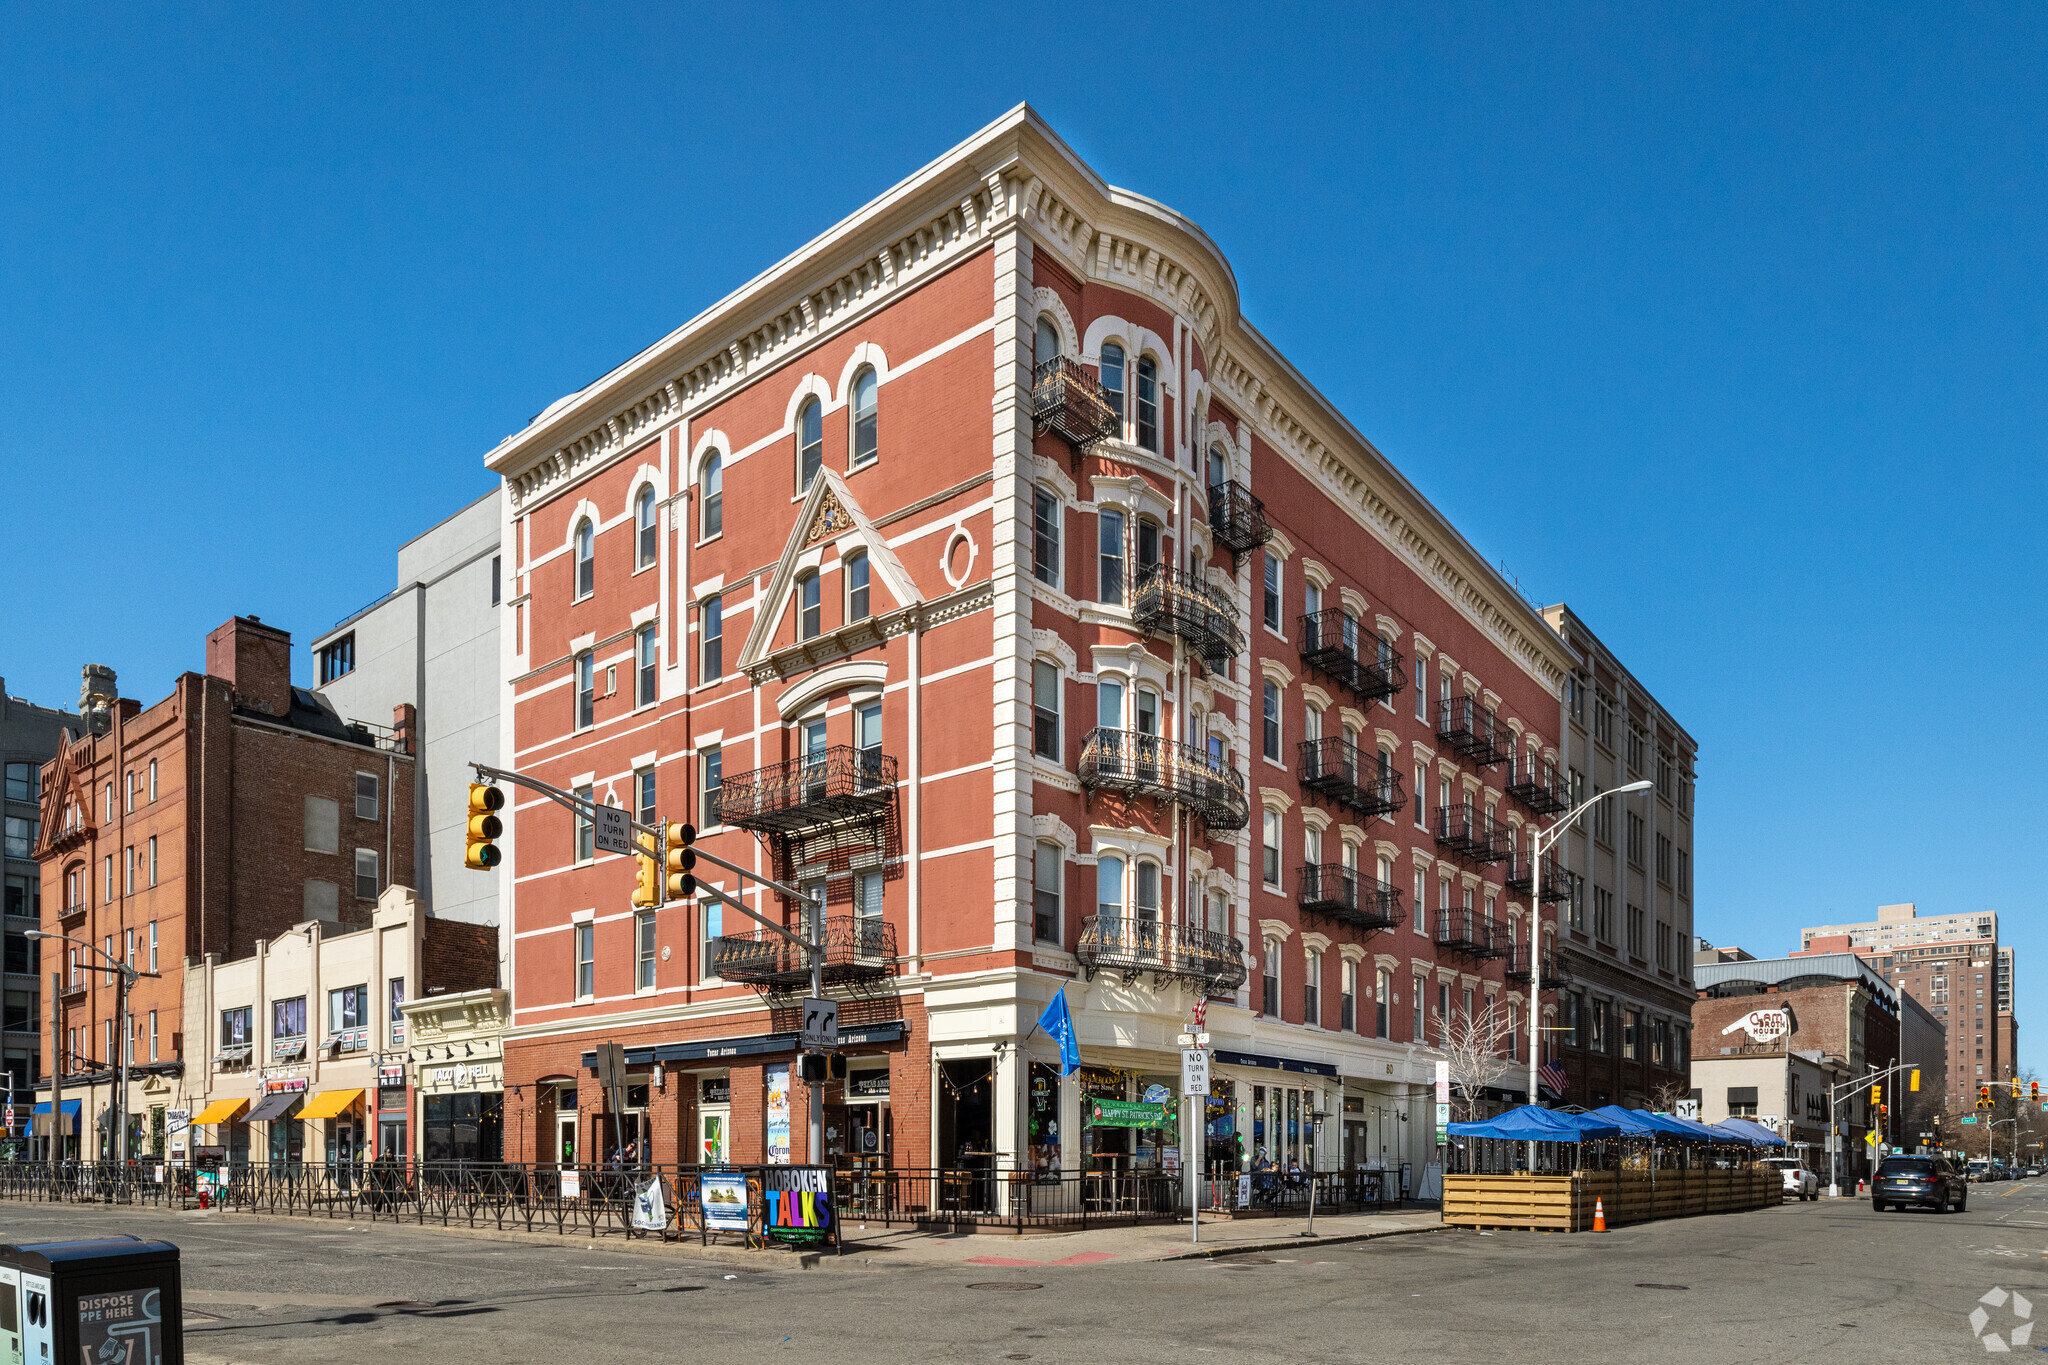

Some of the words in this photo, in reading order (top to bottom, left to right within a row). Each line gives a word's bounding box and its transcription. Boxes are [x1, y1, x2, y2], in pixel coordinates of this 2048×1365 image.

[607, 812, 620, 823] NO
[603, 824, 624, 836] TURN
[598, 835, 609, 845] ON
[613, 838, 628, 849] RED
[1750, 1013, 1782, 1025] CLAM
[1759, 1019, 1785, 1028] BROTH
[805, 1033, 820, 1042] ONLY
[822, 1035, 836, 1043] ONLY
[1189, 1053, 1202, 1062] NO
[433, 1068, 453, 1082] TACO
[469, 1063, 490, 1078] BELL
[1188, 1064, 1204, 1072] TURN
[1386, 1063, 1393, 1075] 80
[1191, 1074, 1201, 1082] ON
[1190, 1084, 1202, 1092] RED
[1102, 1108, 1121, 1118] HAPPY
[1129, 1110, 1154, 1120] PATRICK'S
[765, 1169, 828, 1193] HOBOKEN
[765, 1190, 830, 1229] TALKS
[79, 1294, 134, 1311] DISPOSE
[80, 1311, 102, 1323] PPE
[105, 1306, 134, 1319] HERE
